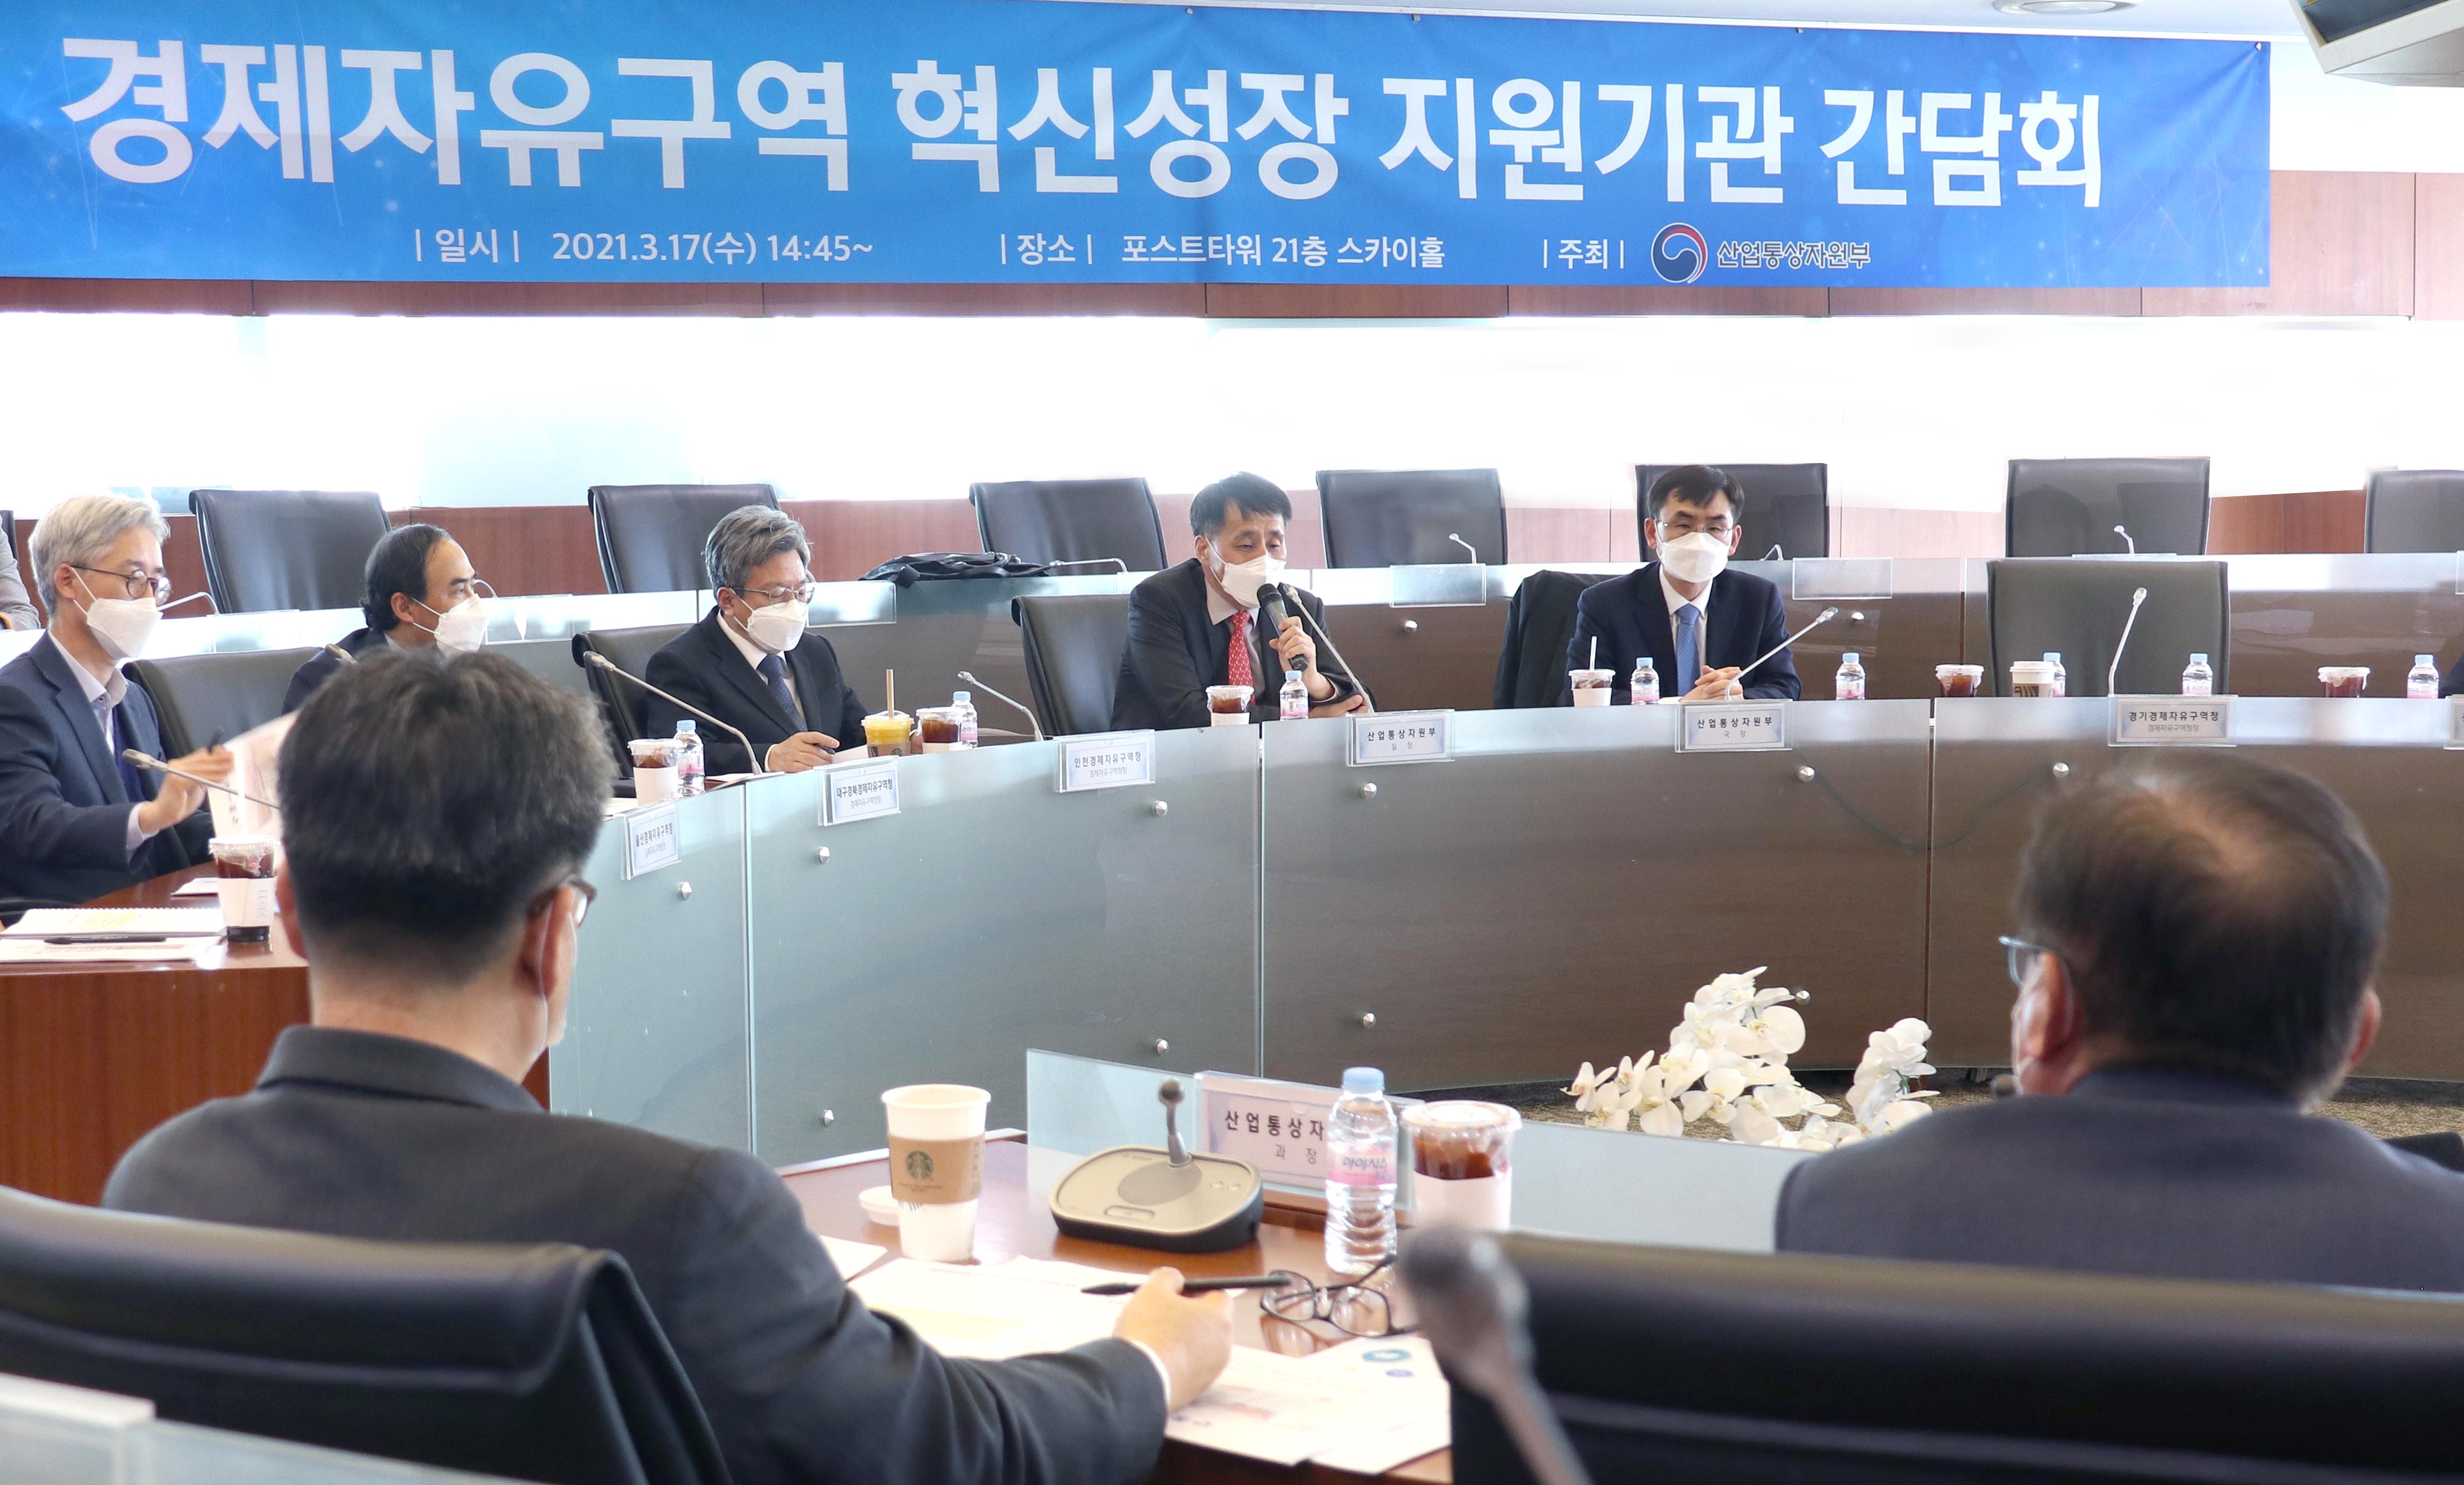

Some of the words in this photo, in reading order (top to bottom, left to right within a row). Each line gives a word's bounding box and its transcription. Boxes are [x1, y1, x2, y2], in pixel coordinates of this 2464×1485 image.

[61, 38, 848, 191] 경제자유구역
[892, 60, 1349, 200] 혁신성장
[1379, 78, 1794, 203] 지원기관
[1820, 89, 2101, 208] 간담회
[436, 229, 498, 263] 일시
[553, 232, 756, 264] 2021.3.17(수)
[768, 235, 872, 261] 14:45~
[1018, 233, 1076, 265] 장소
[1122, 234, 1261, 266] 포스트타워
[1272, 236, 1328, 267] 21층
[1337, 236, 1445, 268] 스카이홀
[1558, 239, 1608, 269] 주최
[1716, 240, 1871, 270] 산업통상자원부
[1698, 716, 1773, 729] 산업통상자원부
[2129, 711, 2219, 722] 경기경제자유구역청
[1367, 727, 1436, 741] 산업통상자원부
[1074, 751, 1141, 768] 인천경제자유구역청
[836, 778, 893, 799] 대구경북경제자유구역청
[1225, 1110, 1324, 1141] 산업통상자
